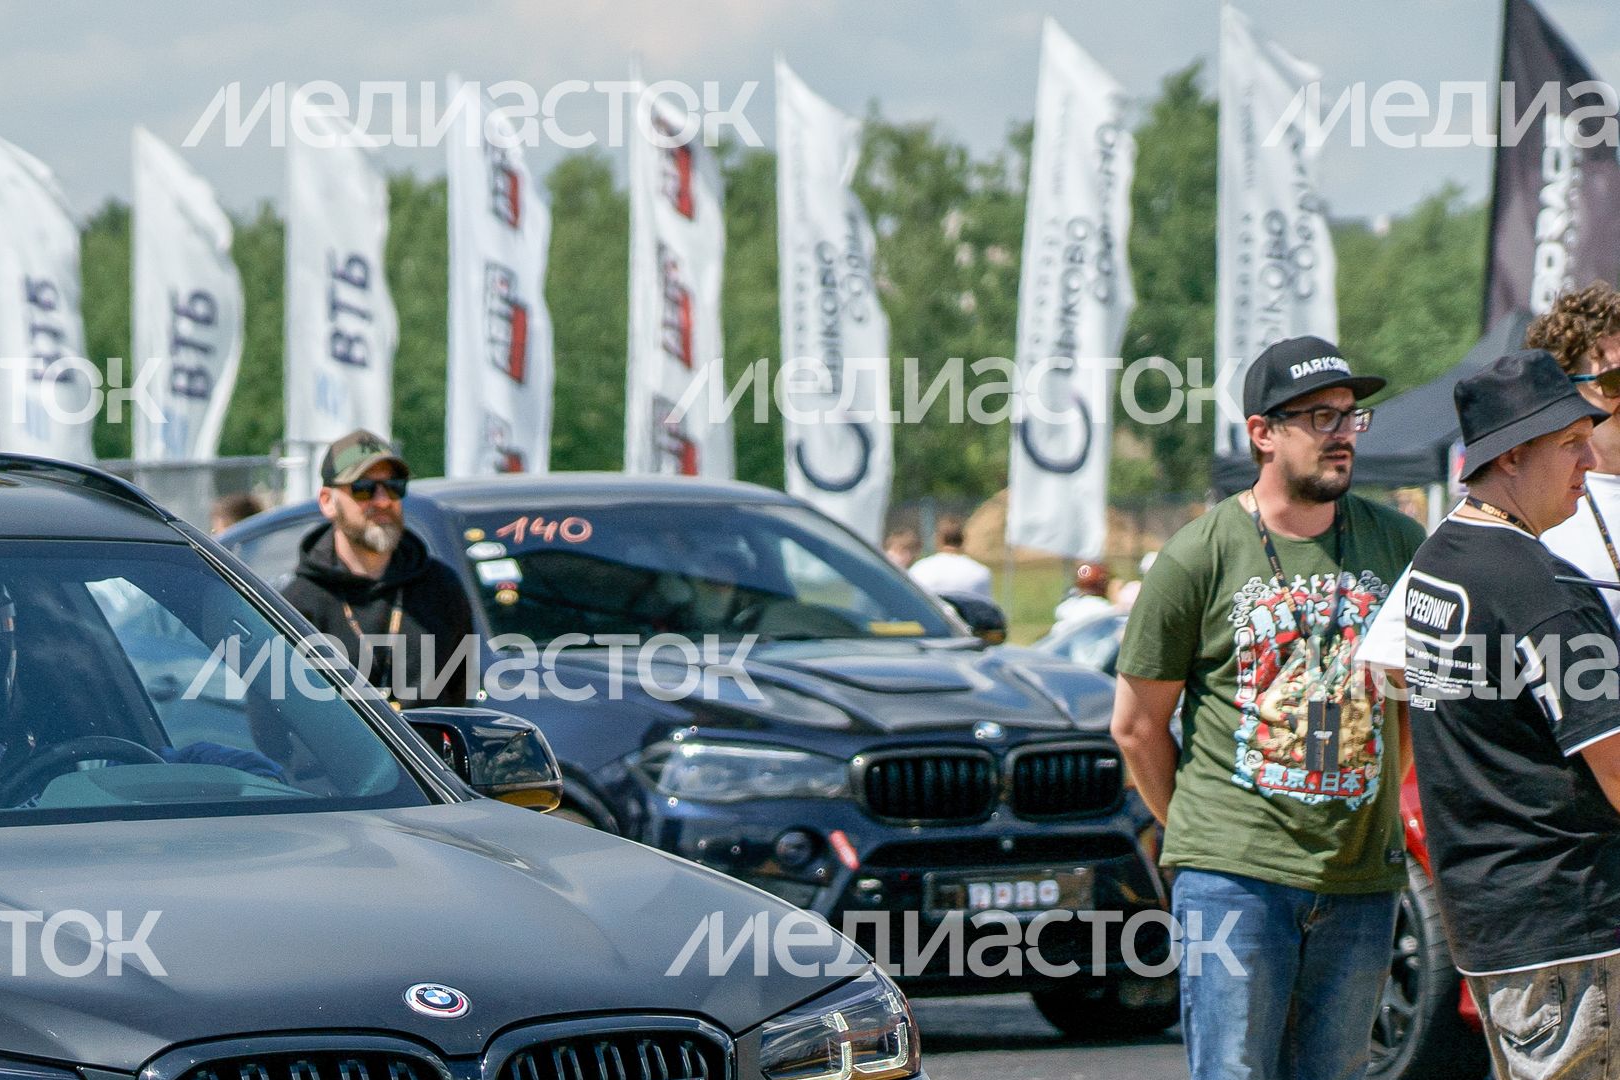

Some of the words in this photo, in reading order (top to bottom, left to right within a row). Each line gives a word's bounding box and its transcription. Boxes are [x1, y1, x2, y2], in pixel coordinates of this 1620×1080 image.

[170, 287, 220, 400] ВТБ
[329, 252, 371, 368] ВТБ
[495, 516, 593, 544] 140
[1406, 588, 1457, 630] SPEEDWAY
